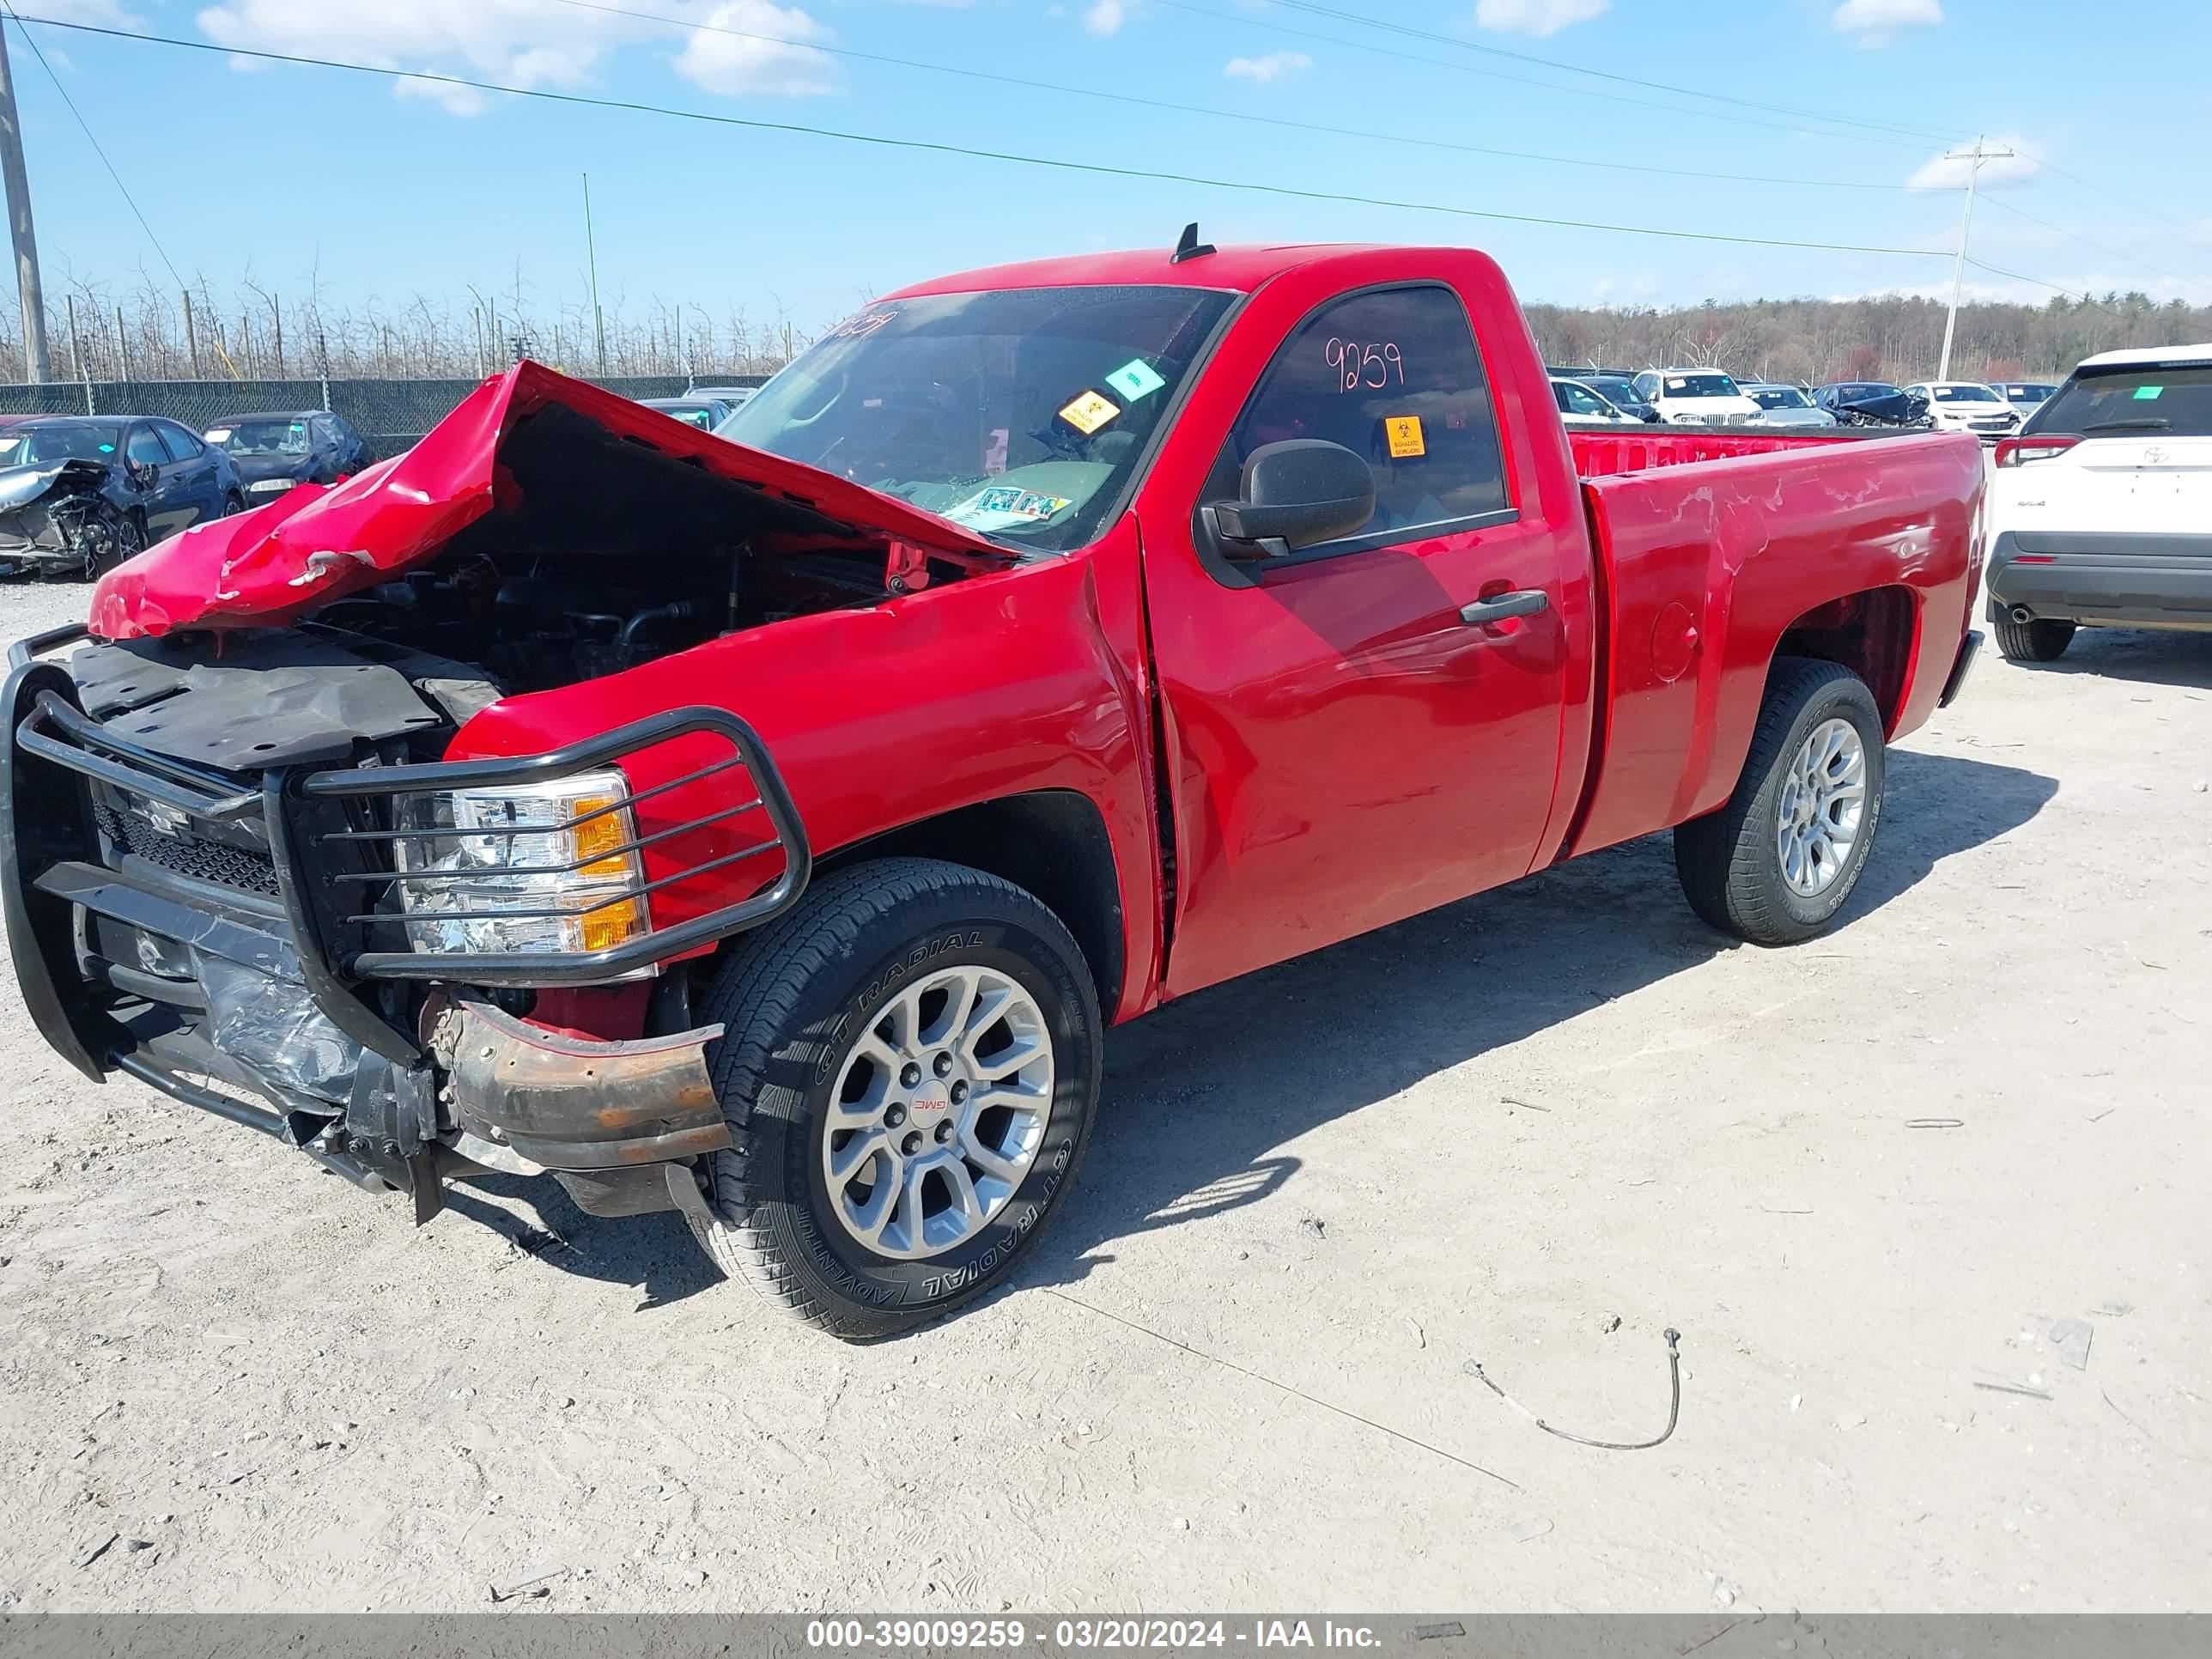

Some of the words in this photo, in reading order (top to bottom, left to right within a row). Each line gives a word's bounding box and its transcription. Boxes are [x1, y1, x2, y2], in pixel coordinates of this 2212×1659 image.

[1325, 337, 1404, 394] 9259
[1869, 793, 1881, 836] GT
[1829, 838, 1872, 908] RADIAL
[815, 1011, 853, 1085] GT
[859, 931, 983, 1012] RADIAL
[914, 1100, 945, 1109] GMC
[1042, 1138, 1073, 1206] GT
[921, 1205, 1038, 1297] RADIAL
